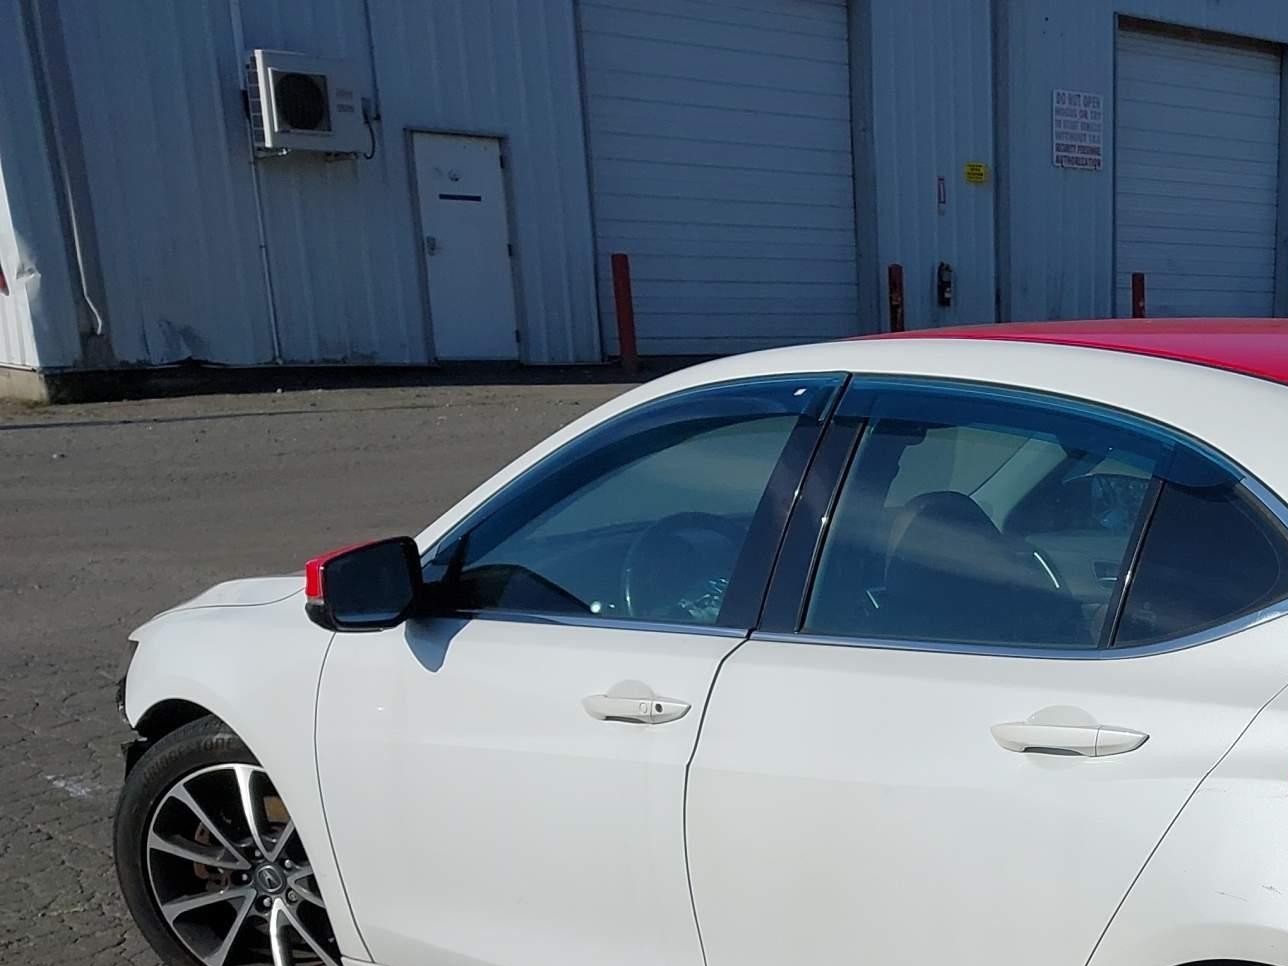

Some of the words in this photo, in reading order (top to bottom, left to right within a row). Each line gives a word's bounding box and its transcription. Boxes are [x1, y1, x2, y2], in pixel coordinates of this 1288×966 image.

[1056, 91, 1067, 105] DO
[1068, 92, 1081, 107] NOT
[1083, 94, 1100, 110] OPEN
